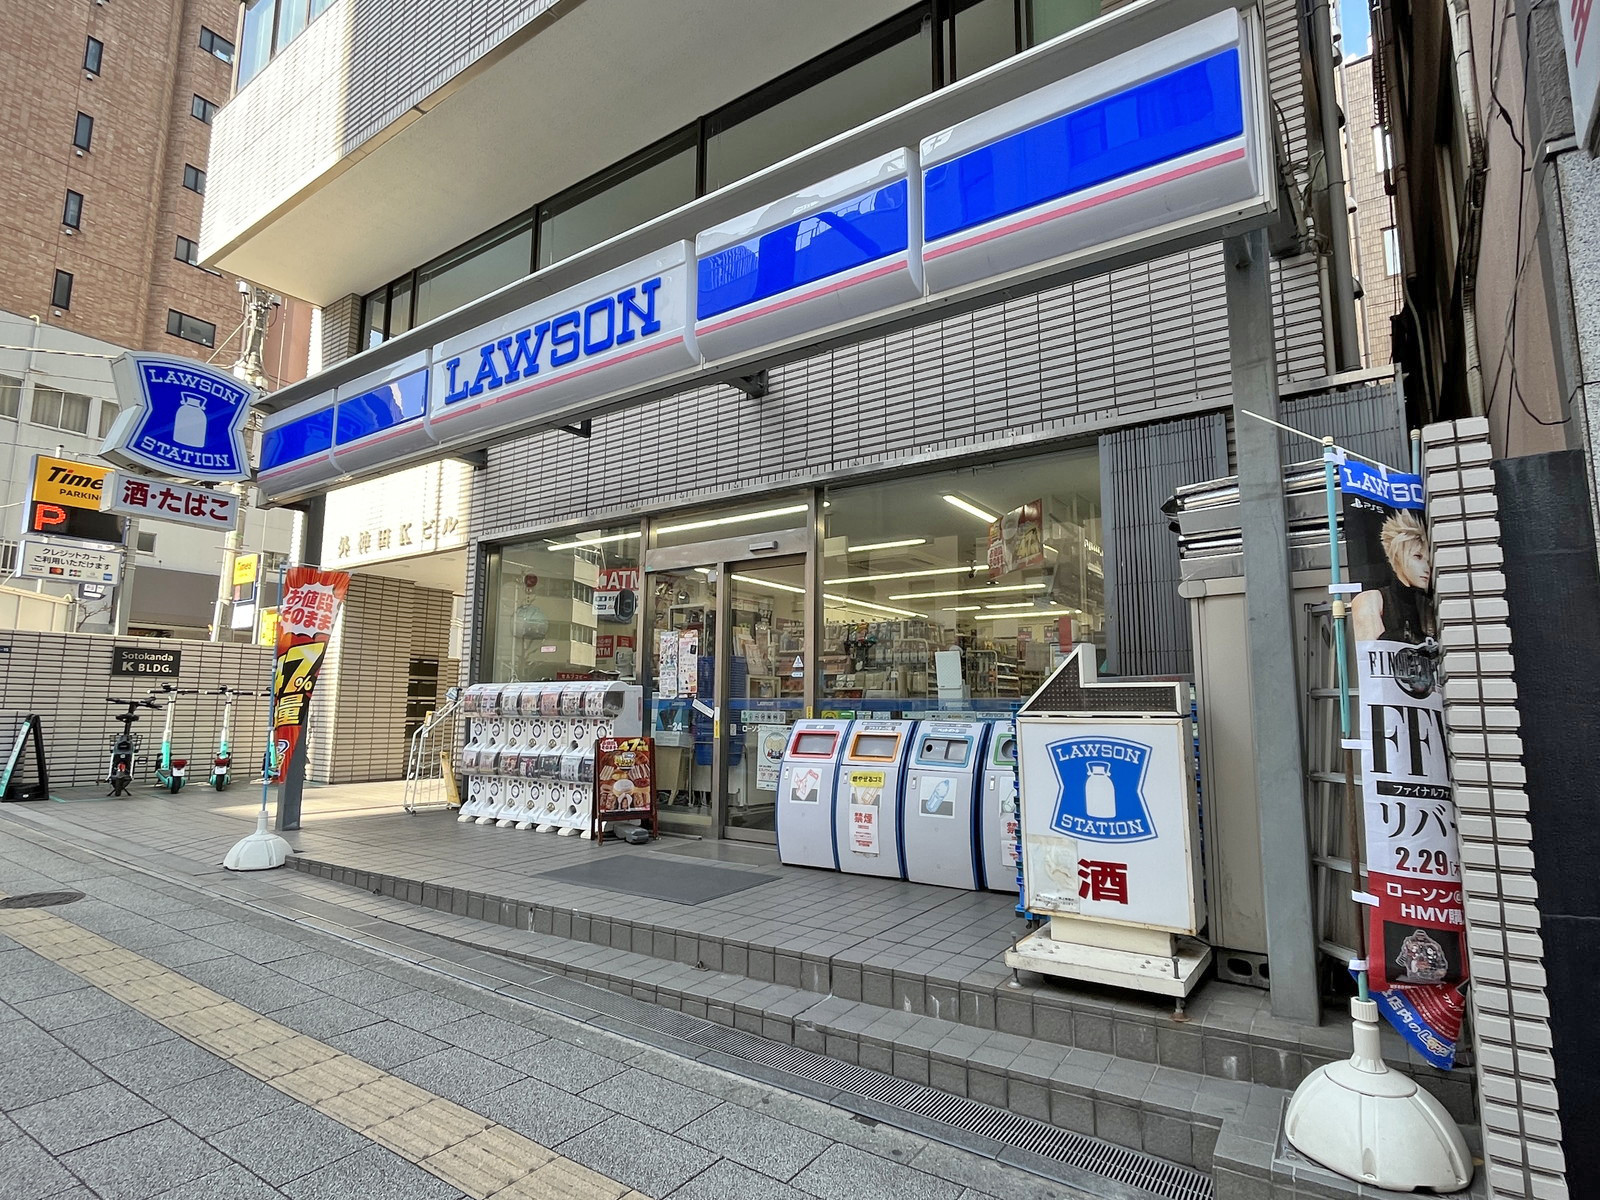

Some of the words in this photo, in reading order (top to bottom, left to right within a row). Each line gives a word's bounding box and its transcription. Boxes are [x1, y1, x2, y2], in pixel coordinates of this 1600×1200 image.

[445, 277, 661, 404] LAWSON
[148, 368, 239, 406] LAWSON
[140, 436, 230, 467] STATION
[59, 489, 102, 501] PARKIN
[122, 479, 230, 521] 酒・たばこ
[33, 504, 66, 531] P
[33, 555, 111, 571] ご利用いただけます
[42, 548, 106, 562] クレジットカード
[286, 589, 334, 614] お値段
[282, 606, 332, 631] そのまま
[122, 651, 174, 662] Sotokanda
[122, 661, 134, 671] K
[138, 663, 173, 673] BLDG.
[274, 693, 304, 728] 量
[1056, 743, 1142, 765] LAWSON
[854, 812, 873, 825] 禁煙
[1061, 813, 1145, 836] STATION
[1077, 858, 1129, 905] 酒
